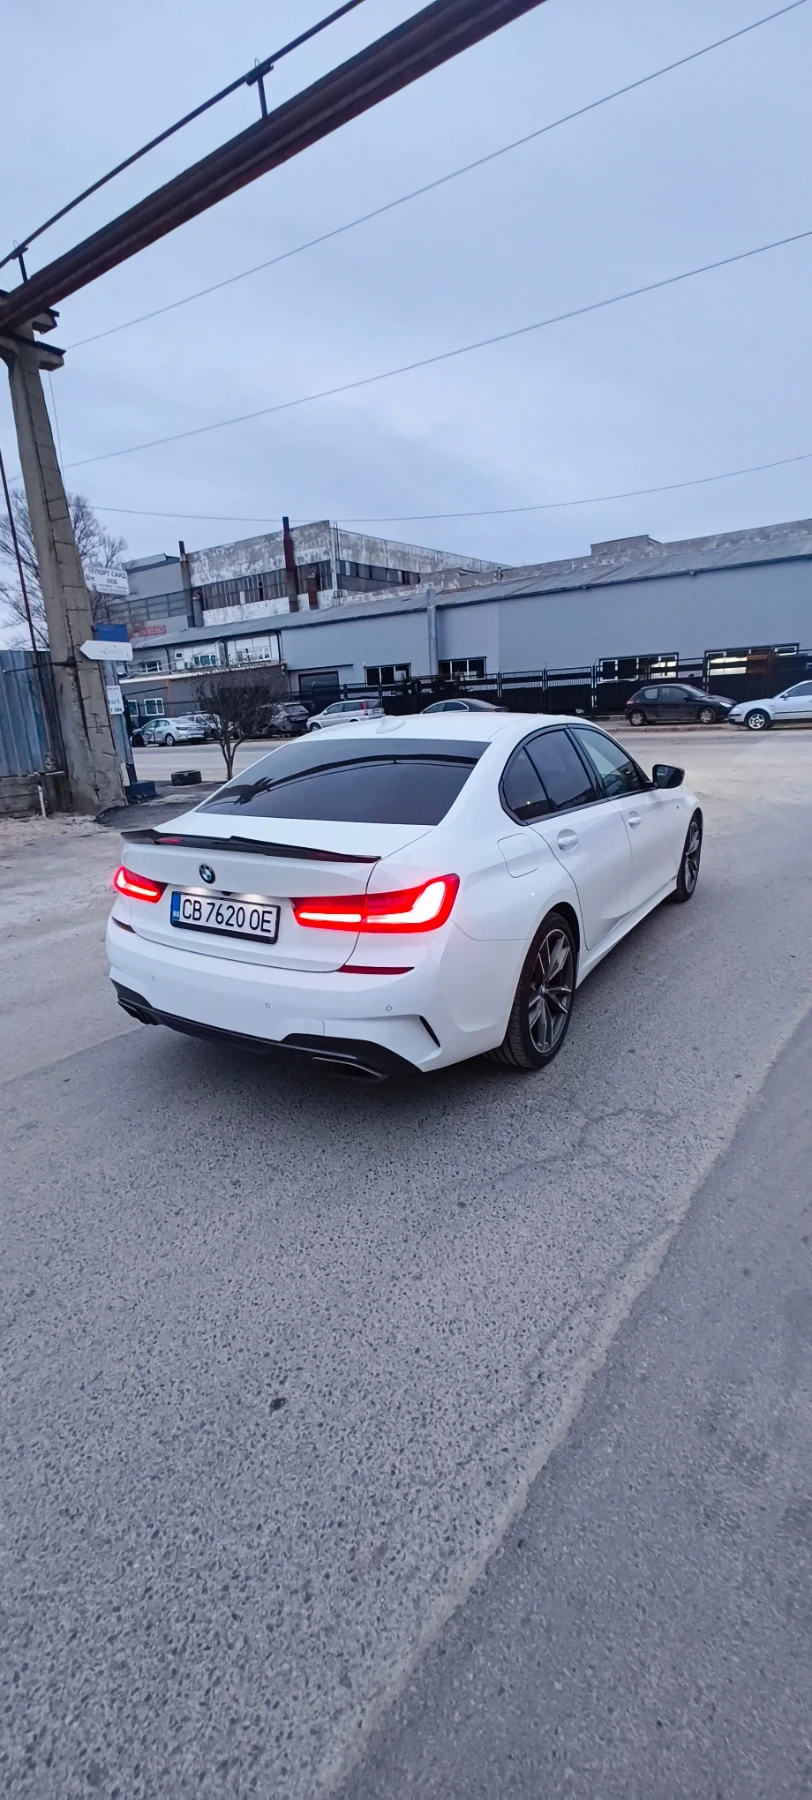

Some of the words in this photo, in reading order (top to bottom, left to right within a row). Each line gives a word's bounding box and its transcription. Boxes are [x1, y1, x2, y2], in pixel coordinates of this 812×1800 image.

[95, 568, 110, 576] ПОРТ
[111, 570, 127, 579] САИД
[172, 910, 180, 918] BG
[182, 898, 202, 921] CB
[205, 902, 246, 928] 7620
[249, 909, 273, 933] OE
